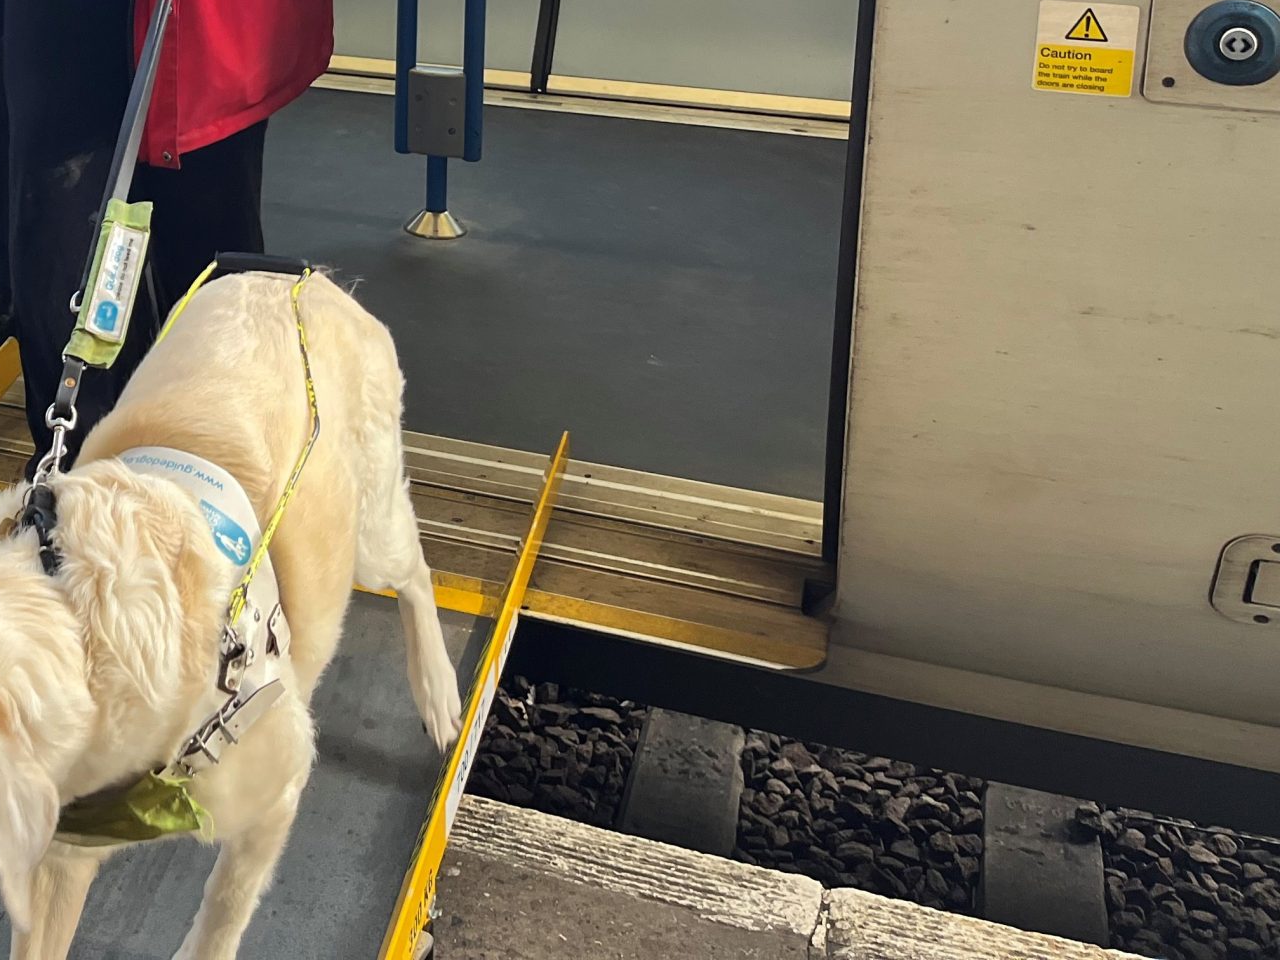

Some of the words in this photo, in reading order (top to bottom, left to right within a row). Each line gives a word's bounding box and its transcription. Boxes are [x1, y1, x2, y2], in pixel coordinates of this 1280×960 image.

[1040, 47, 1092, 61] Caution
[1067, 64, 1077, 72] try
[1090, 66, 1113, 74] board
[1095, 74, 1108, 82] the
[1076, 83, 1105, 92] closing
